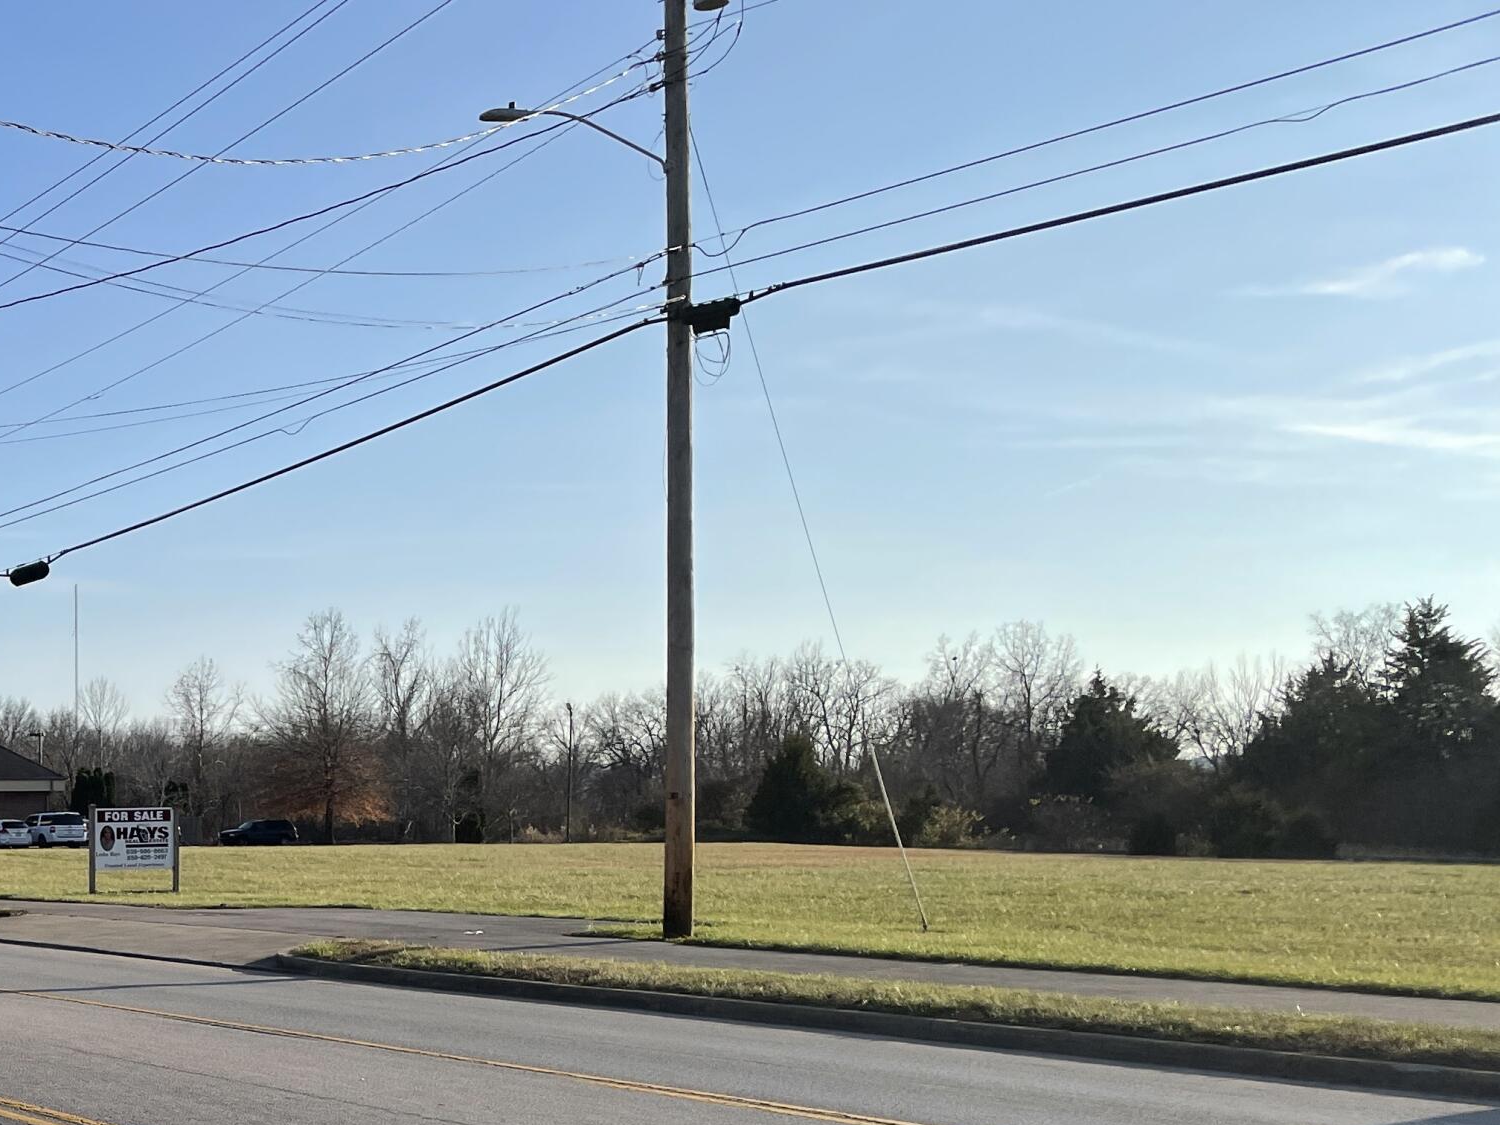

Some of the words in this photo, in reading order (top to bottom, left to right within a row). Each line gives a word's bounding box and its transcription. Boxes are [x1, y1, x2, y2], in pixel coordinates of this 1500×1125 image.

[104, 811, 129, 822] FOR
[133, 810, 164, 822] SALE
[116, 825, 169, 843] HAYS
